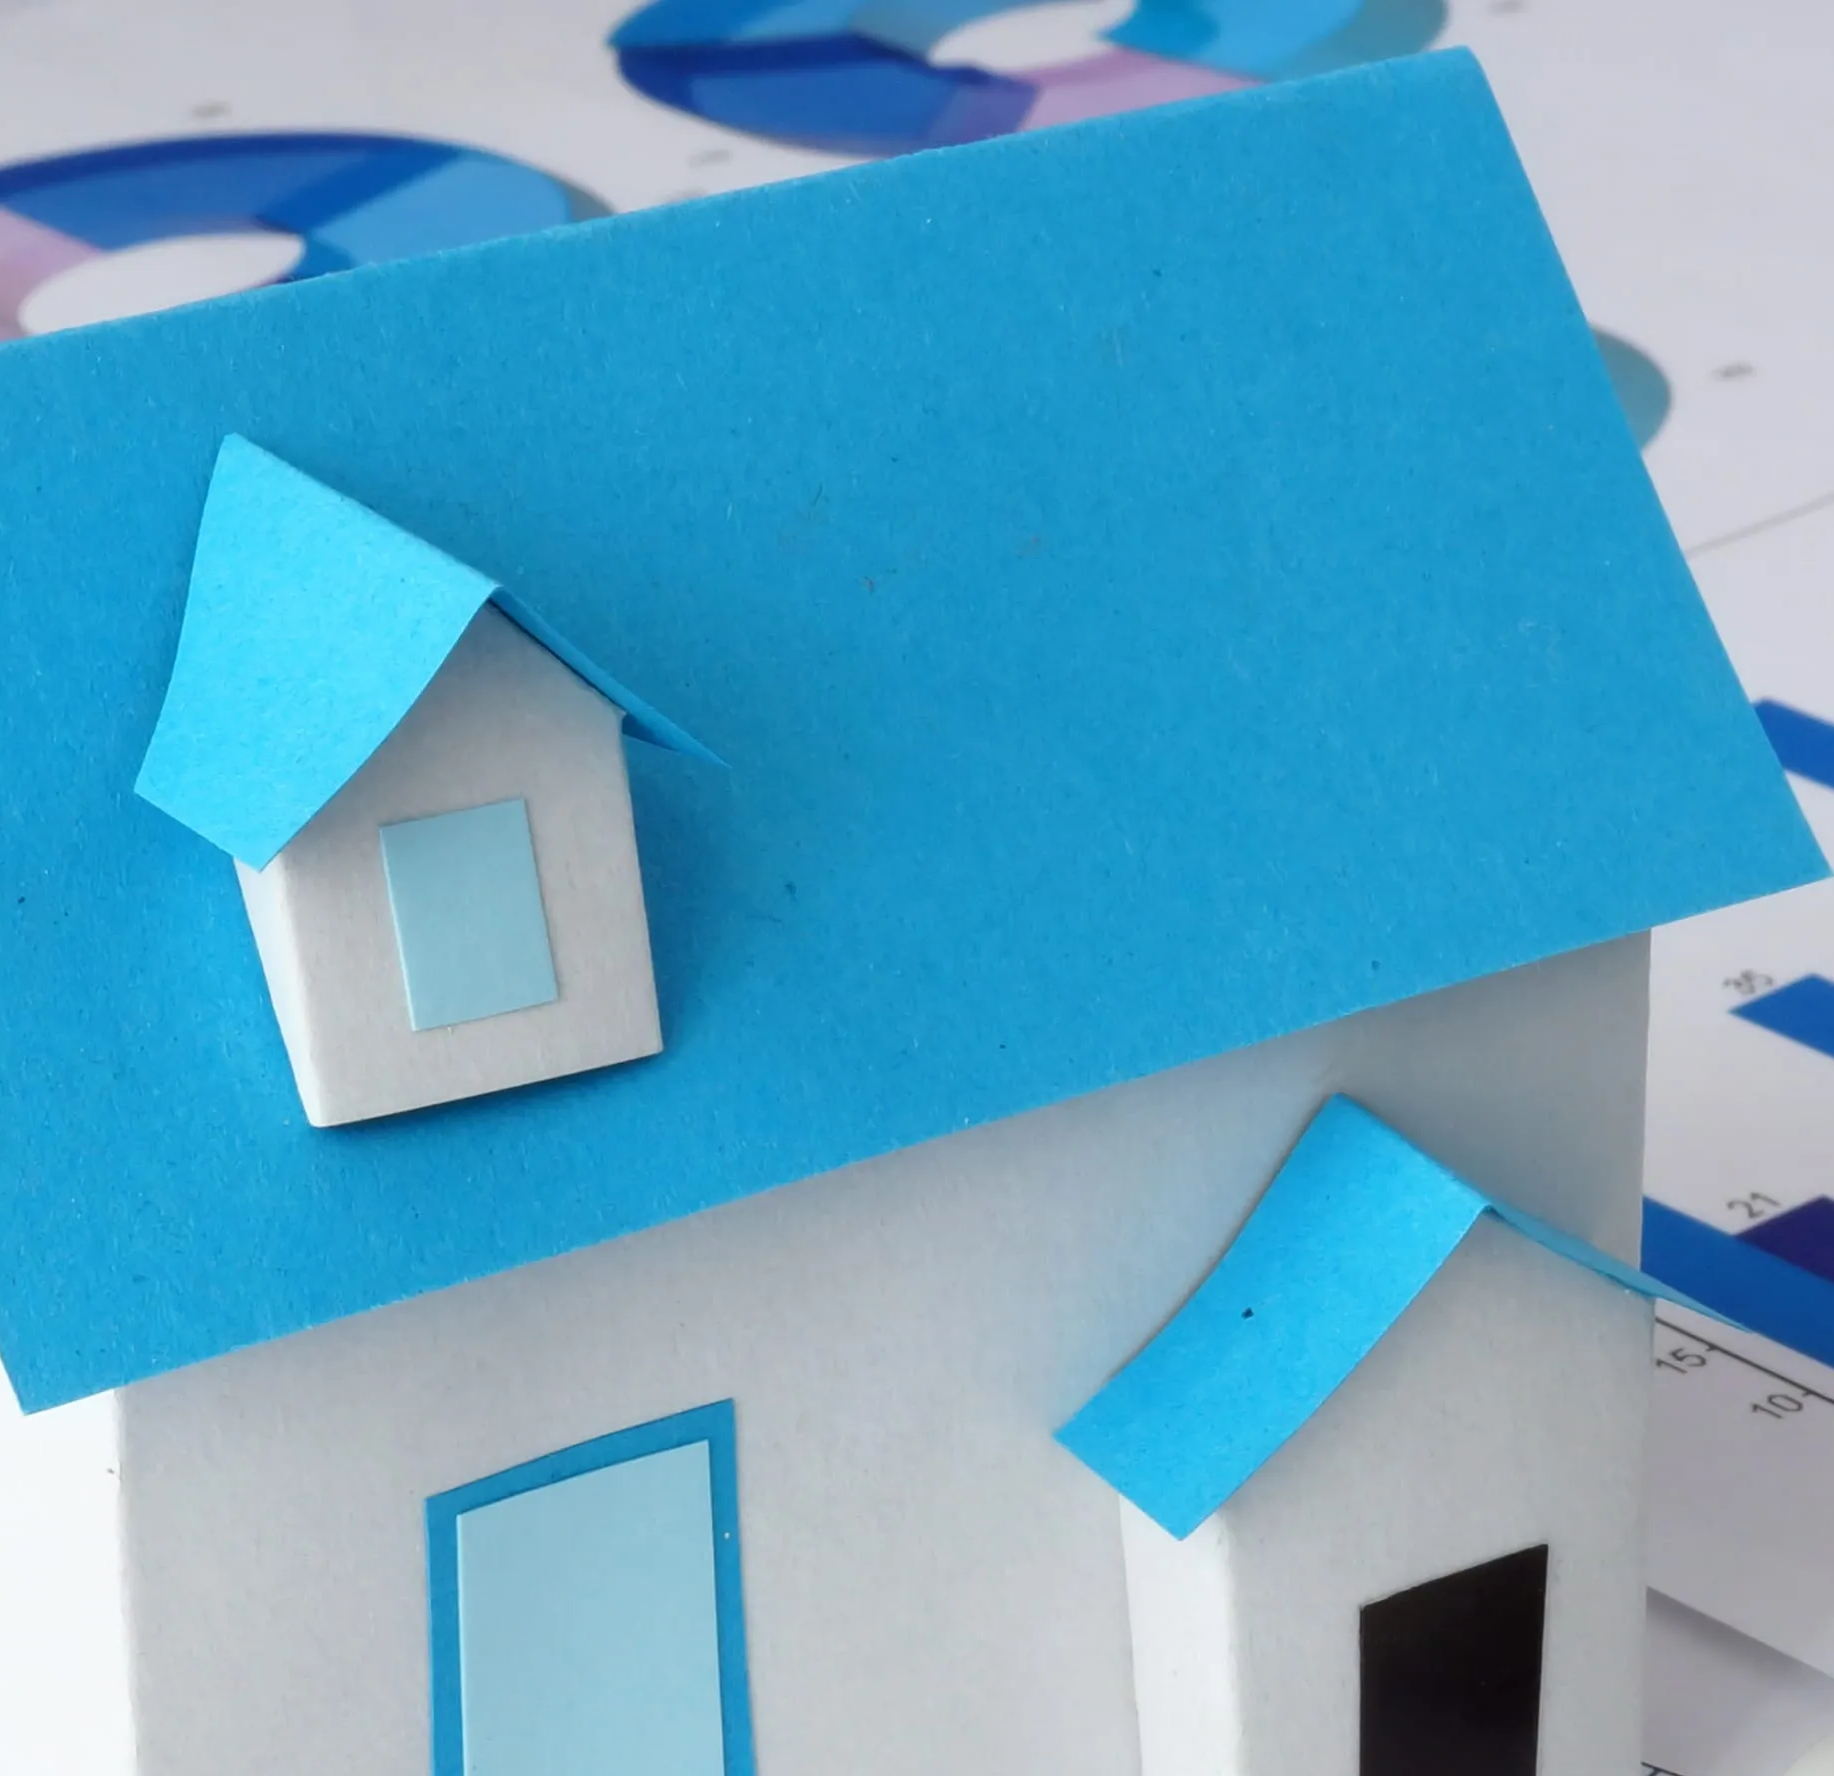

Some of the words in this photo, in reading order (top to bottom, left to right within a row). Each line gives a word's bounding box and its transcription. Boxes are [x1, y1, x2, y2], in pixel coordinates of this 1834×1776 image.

[1727, 1192, 1781, 1219] 21
[1655, 1347, 1707, 1375] 15
[1750, 1393, 1805, 1420] 10
